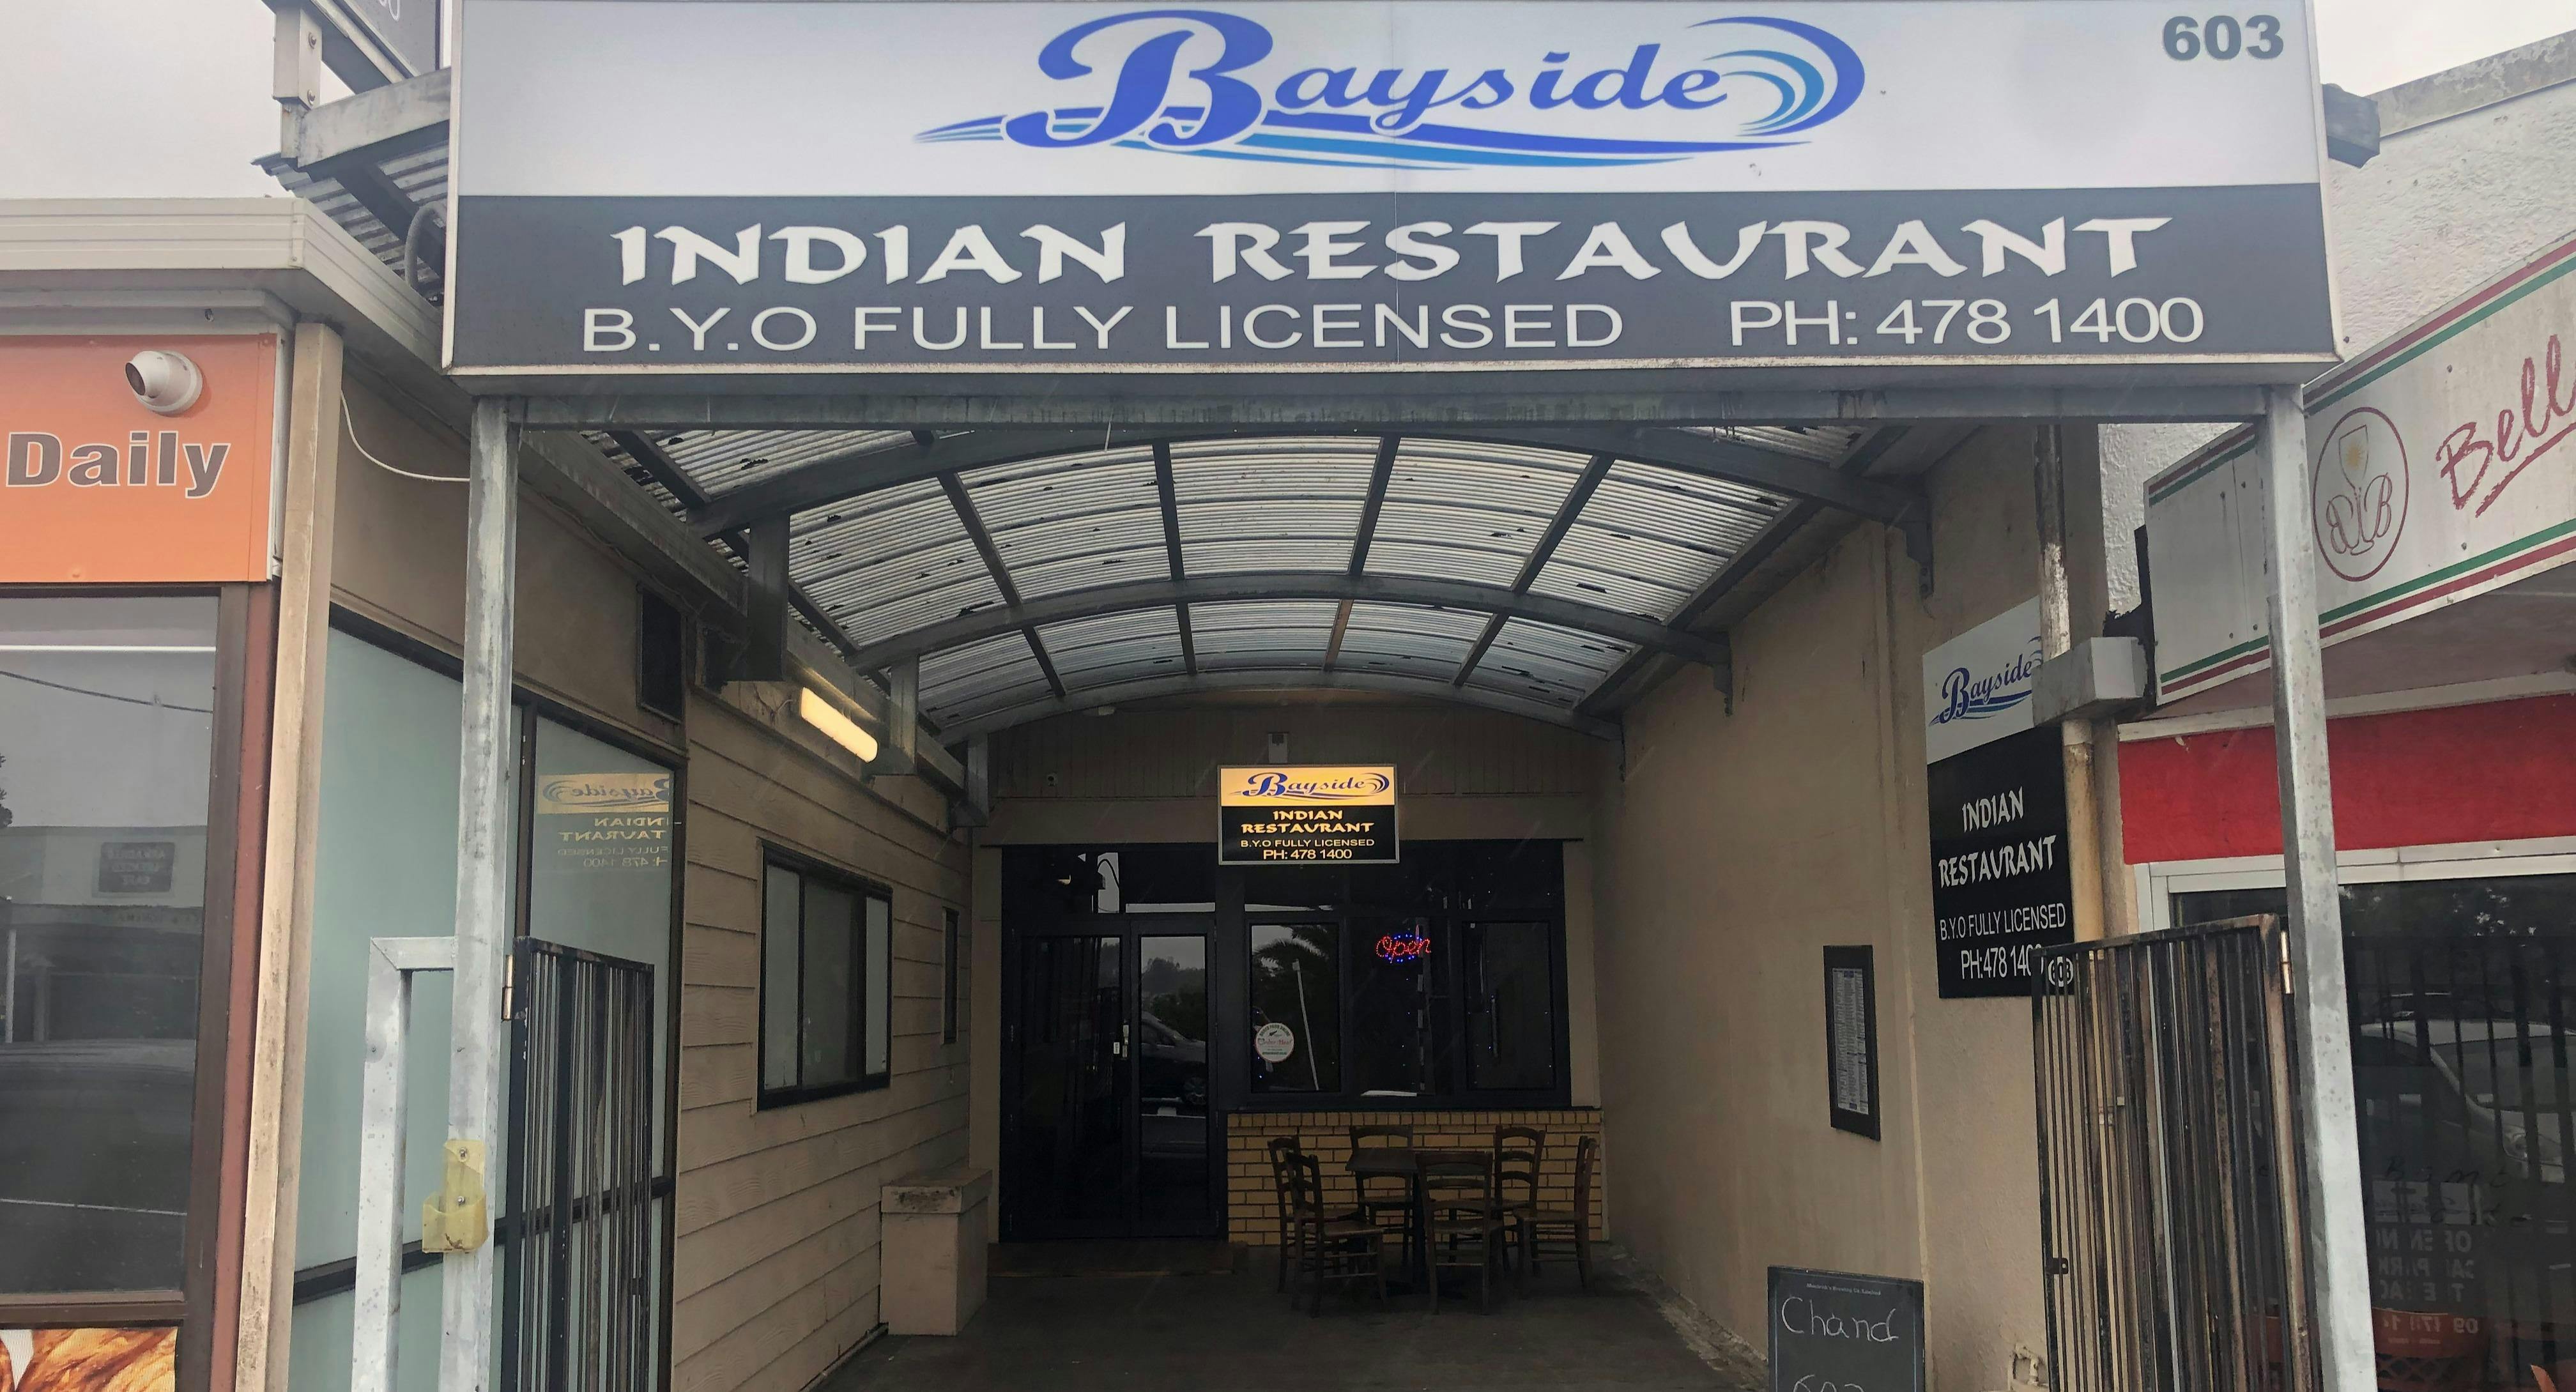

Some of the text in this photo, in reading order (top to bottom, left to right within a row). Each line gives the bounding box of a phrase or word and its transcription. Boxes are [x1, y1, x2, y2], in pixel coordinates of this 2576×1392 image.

[2162, 14, 2284, 61] 603
[1005, 10, 1729, 149] Bayside
[610, 216, 2173, 286] INDIAN RESTAURANT
[583, 297, 2204, 351] B.Y.O FULLY LICENSED PH: 478 1400
[6, 430, 231, 499] Daily
[1939, 654, 2033, 724] Bayside
[1243, 772, 1365, 797] Bayside
[1241, 823, 1375, 834] RESTAURANT
[1273, 810, 1343, 821] INDIAN
[1961, 786, 2024, 833] INDIAN
[1241, 839, 1271, 848] B.Y.O
[1314, 839, 1375, 847] LICENSED
[1263, 849, 1353, 860] PH: 478 1400
[1938, 834, 2057, 889] RESTAURANT
[1940, 902, 2066, 940] B.Y.O FULLY LICENSED
[1376, 935, 1432, 964] Open
[1781, 1295, 1899, 1343] Chand
